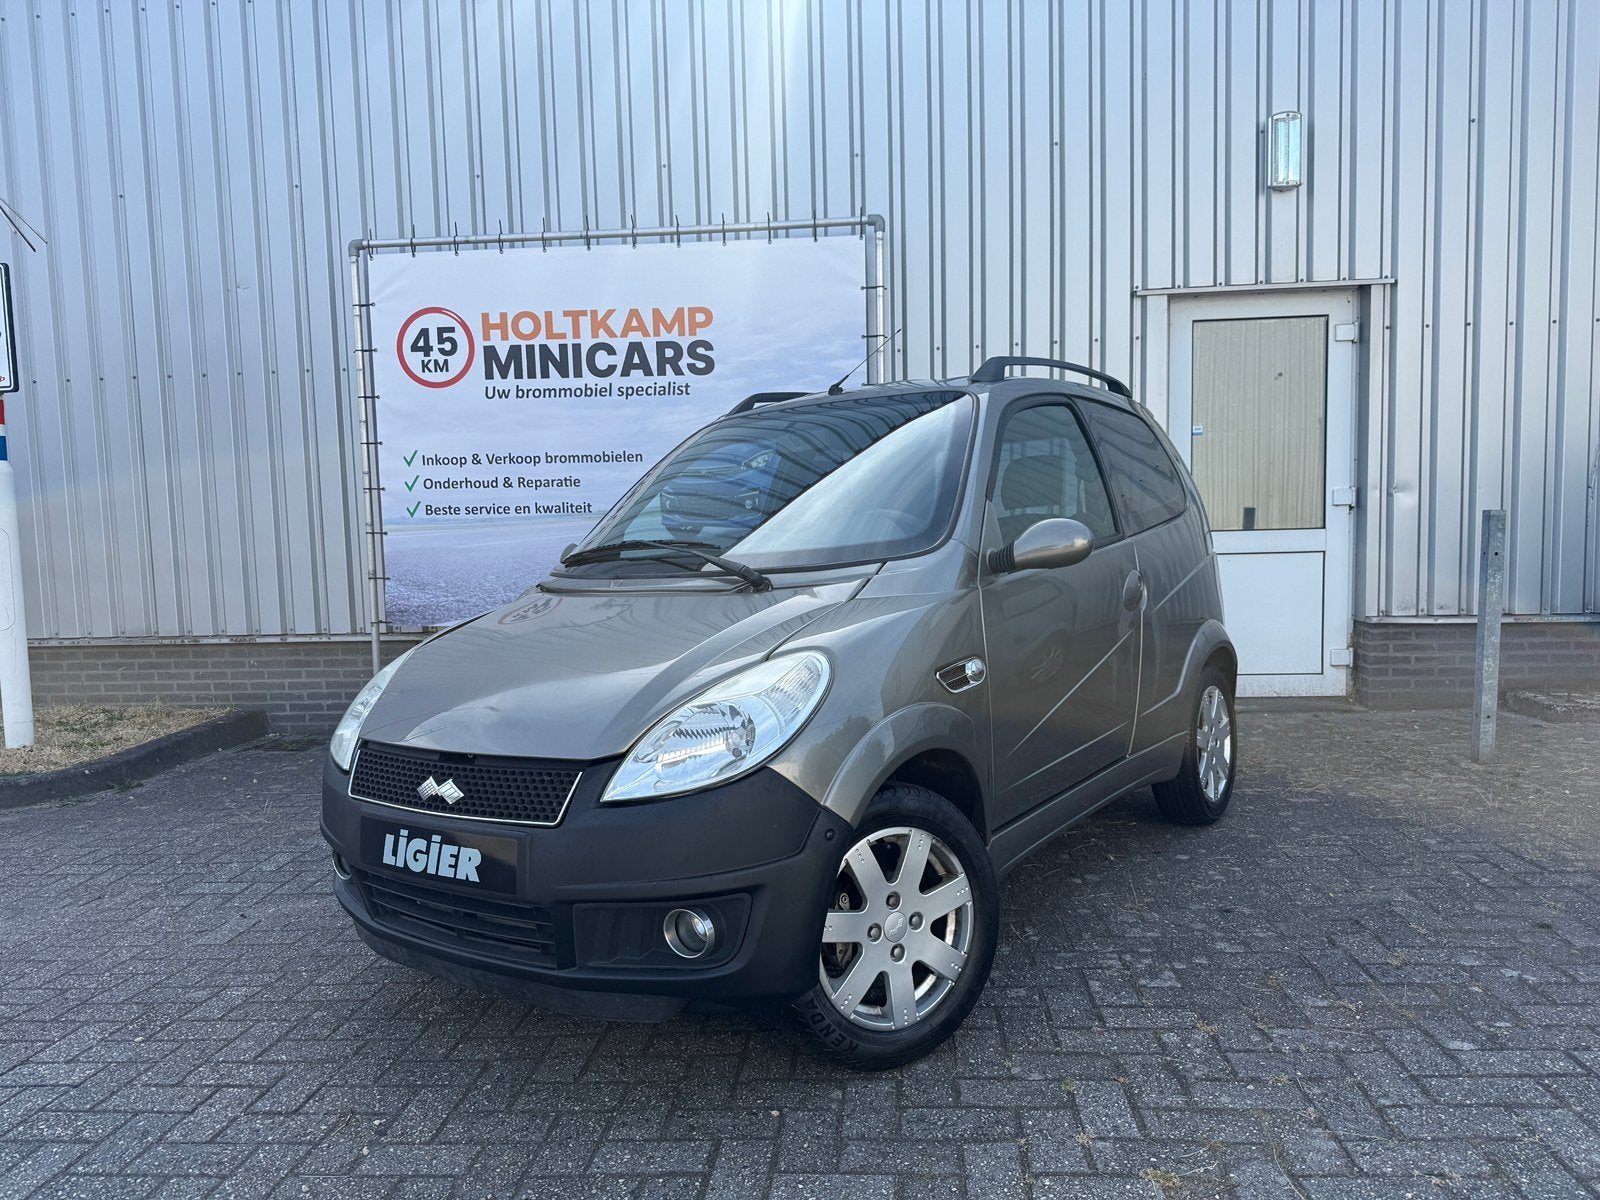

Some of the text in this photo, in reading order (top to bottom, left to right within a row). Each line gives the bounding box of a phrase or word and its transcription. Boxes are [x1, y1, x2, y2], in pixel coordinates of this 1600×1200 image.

[481, 306, 714, 341] HOLTKAMP
[410, 326, 458, 358] 45
[421, 358, 450, 374] KM
[483, 339, 716, 380] MINICARS
[484, 382, 691, 401] Uw brommobiel specialist
[421, 450, 643, 469] Inkoop & Verkoop brommobielen
[423, 476, 581, 491] Onderhoud & Reparatie
[425, 501, 593, 516] Beste service en kwaliteit
